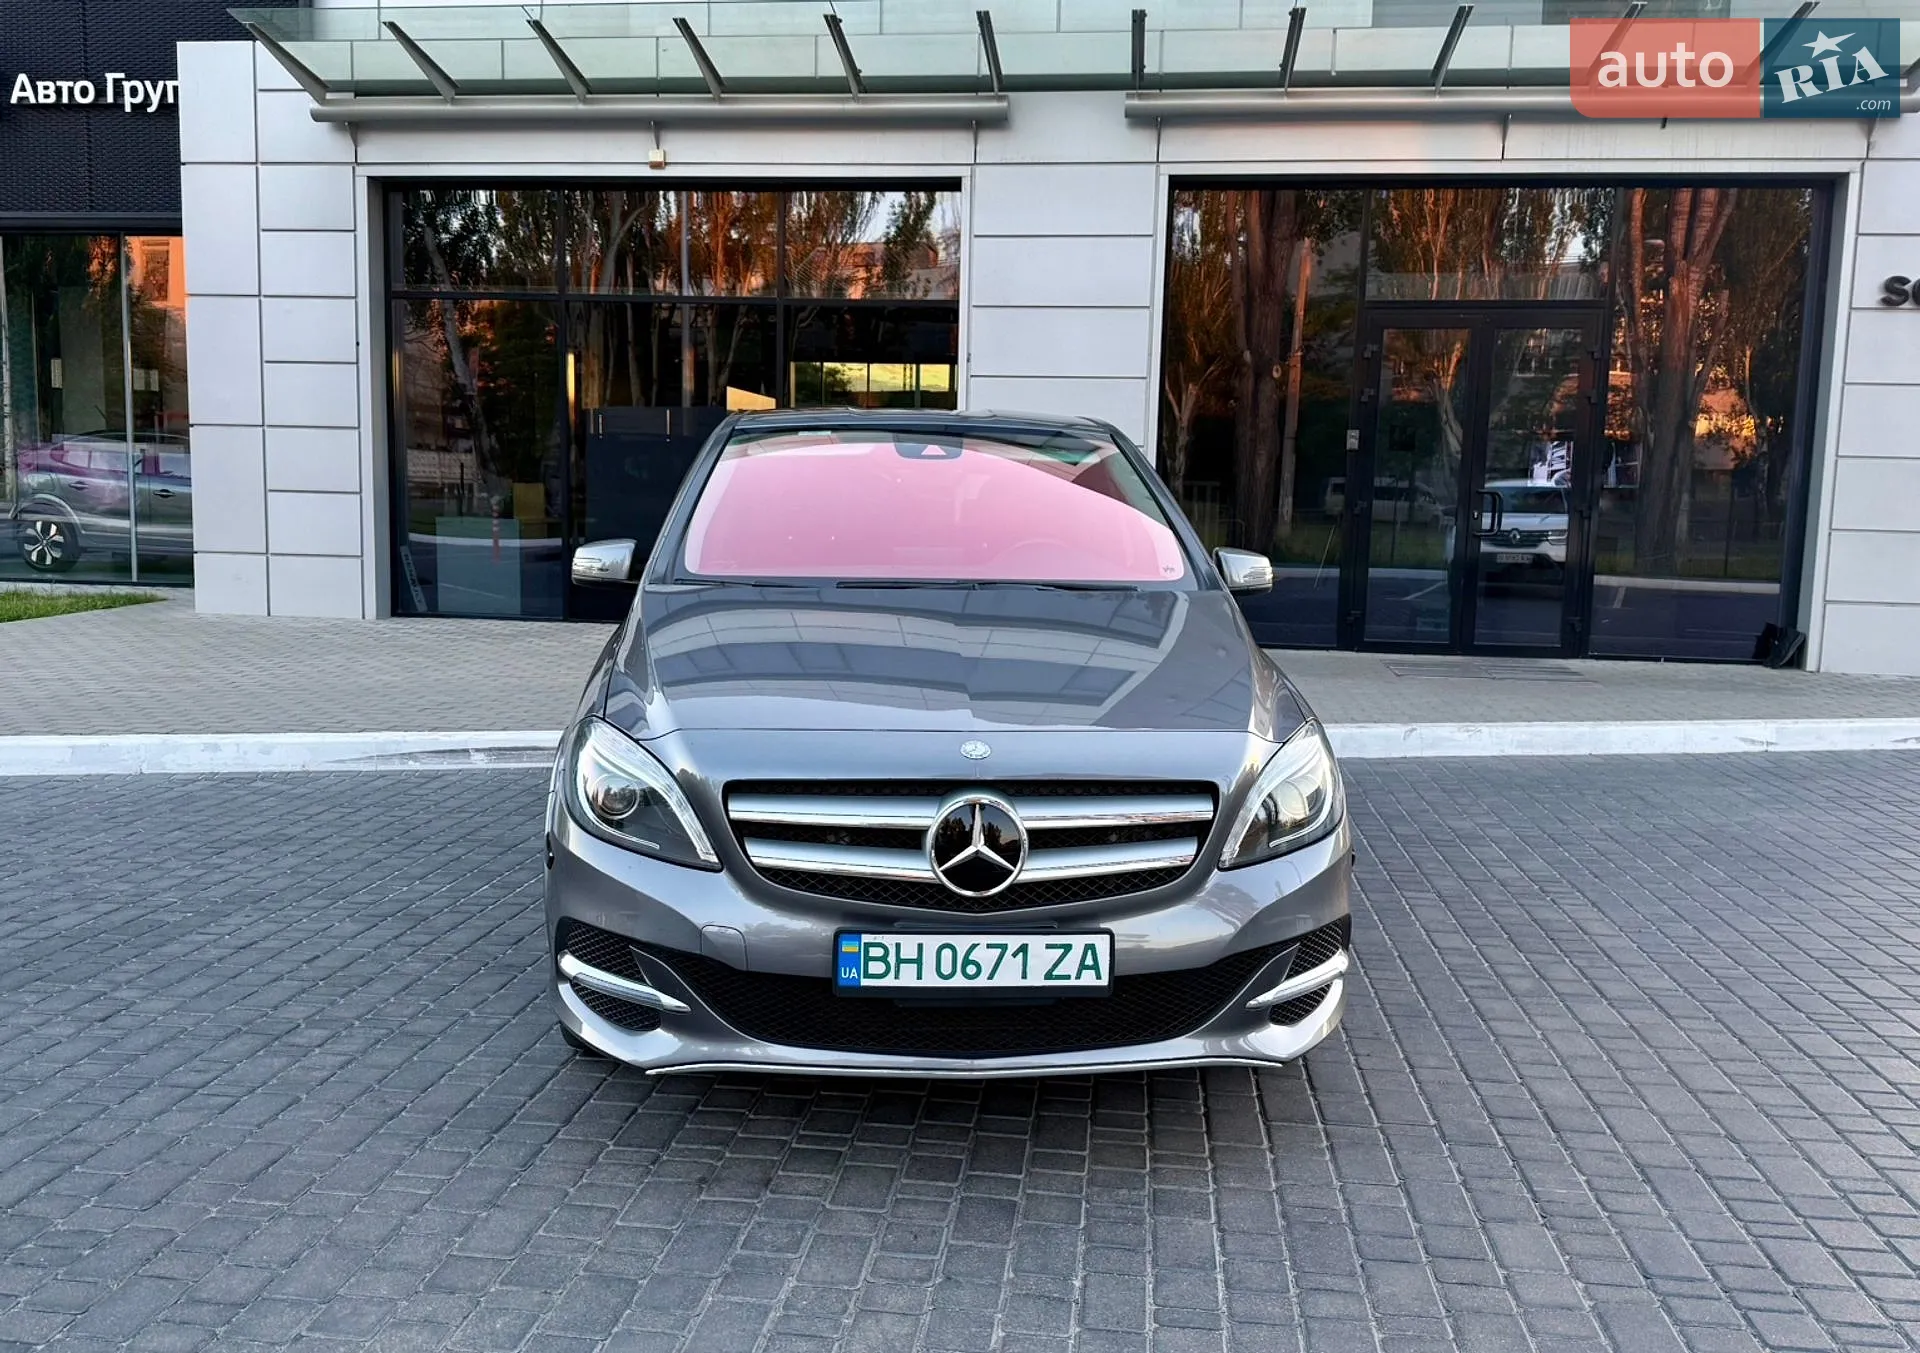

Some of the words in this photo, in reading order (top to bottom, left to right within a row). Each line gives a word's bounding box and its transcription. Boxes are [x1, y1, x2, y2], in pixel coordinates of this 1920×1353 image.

[10, 73, 95, 104] Авто
[841, 967, 858, 979] UA
[862, 942, 924, 980] BH
[935, 942, 1030, 980] 0671
[1043, 943, 1102, 980] ZA
